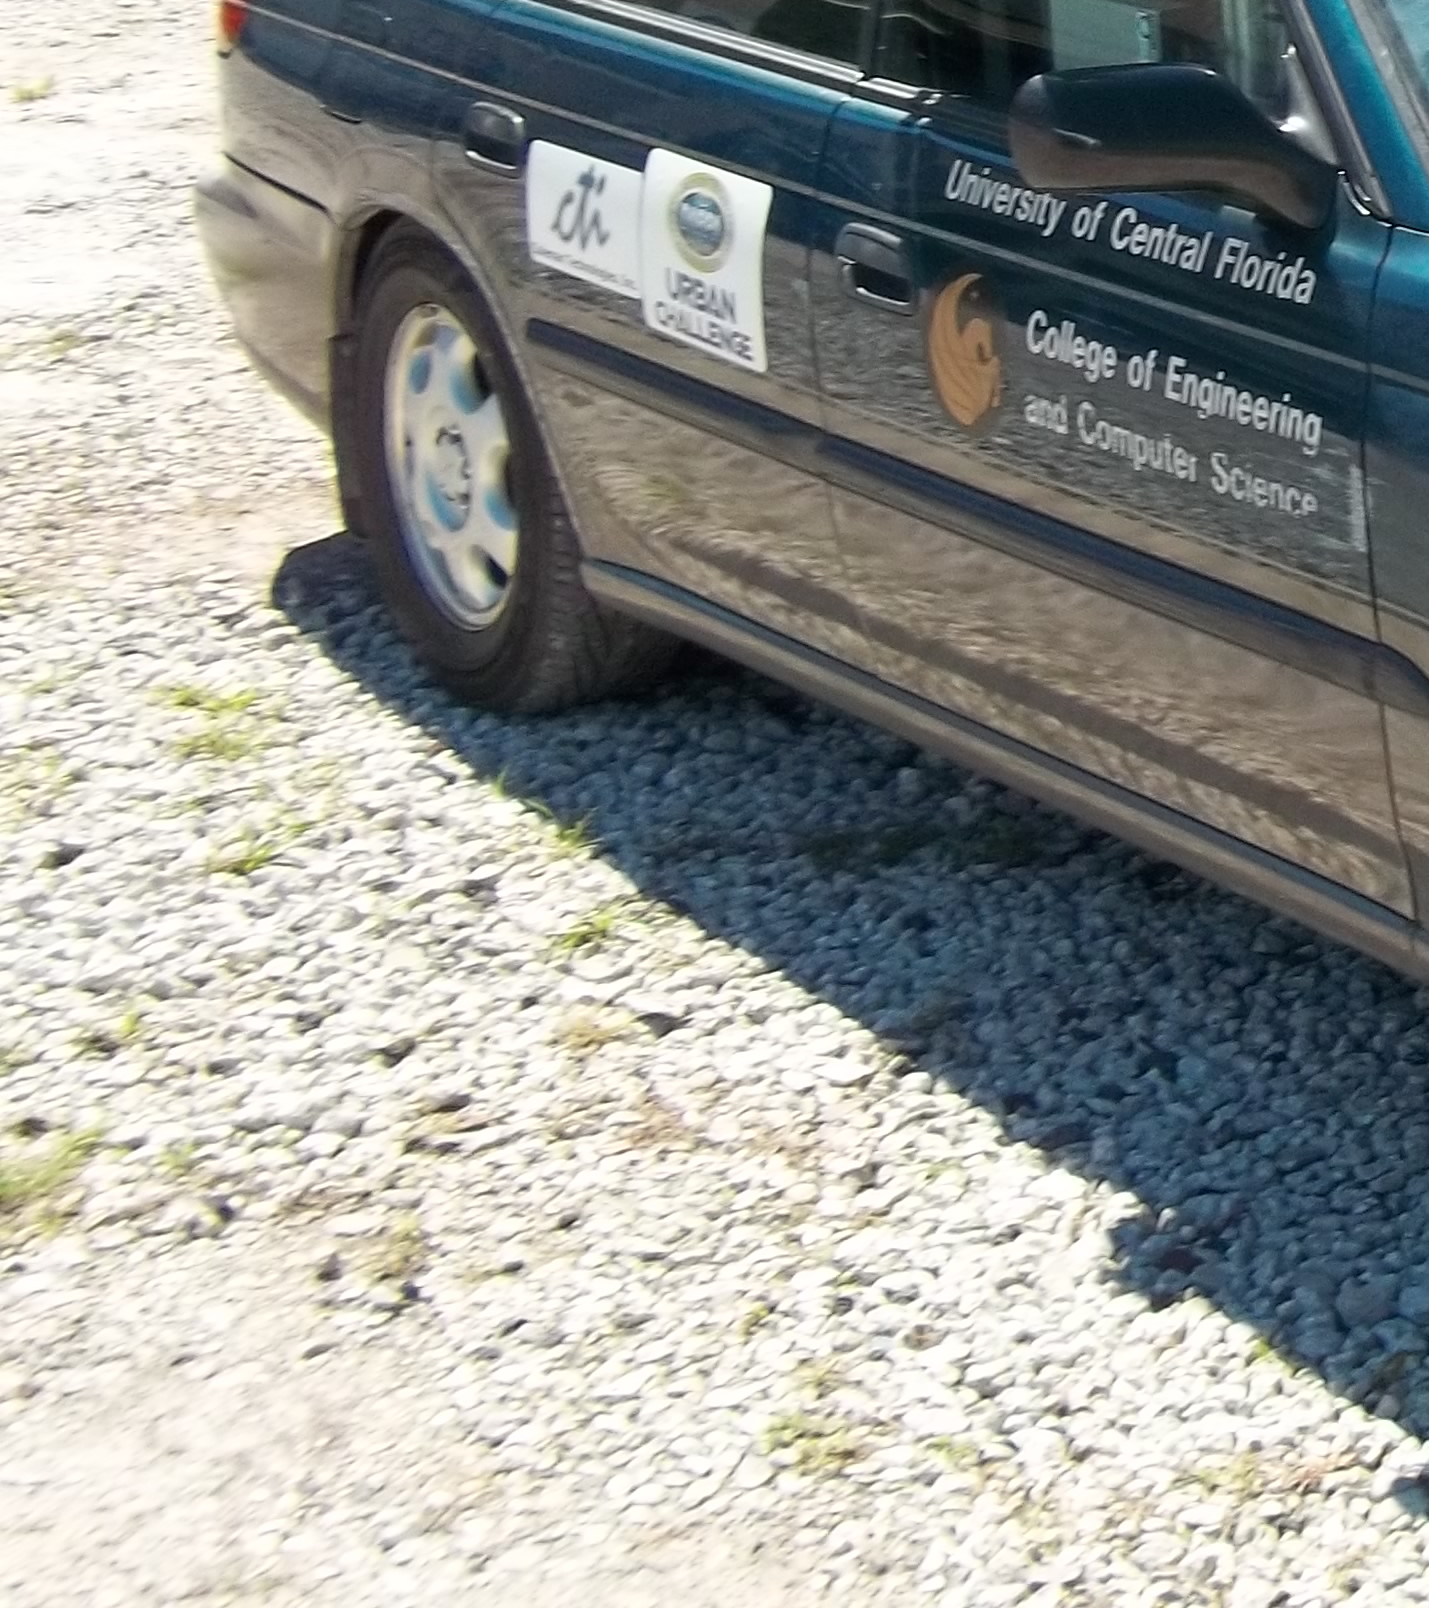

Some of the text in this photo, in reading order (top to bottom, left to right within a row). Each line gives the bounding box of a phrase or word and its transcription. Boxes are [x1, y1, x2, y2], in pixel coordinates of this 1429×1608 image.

[664, 266, 737, 326] URBAN
[944, 159, 1318, 305] University of Central Florida
[1025, 309, 1323, 457] College of Engineering
[1023, 393, 1319, 517] and Computer Science
